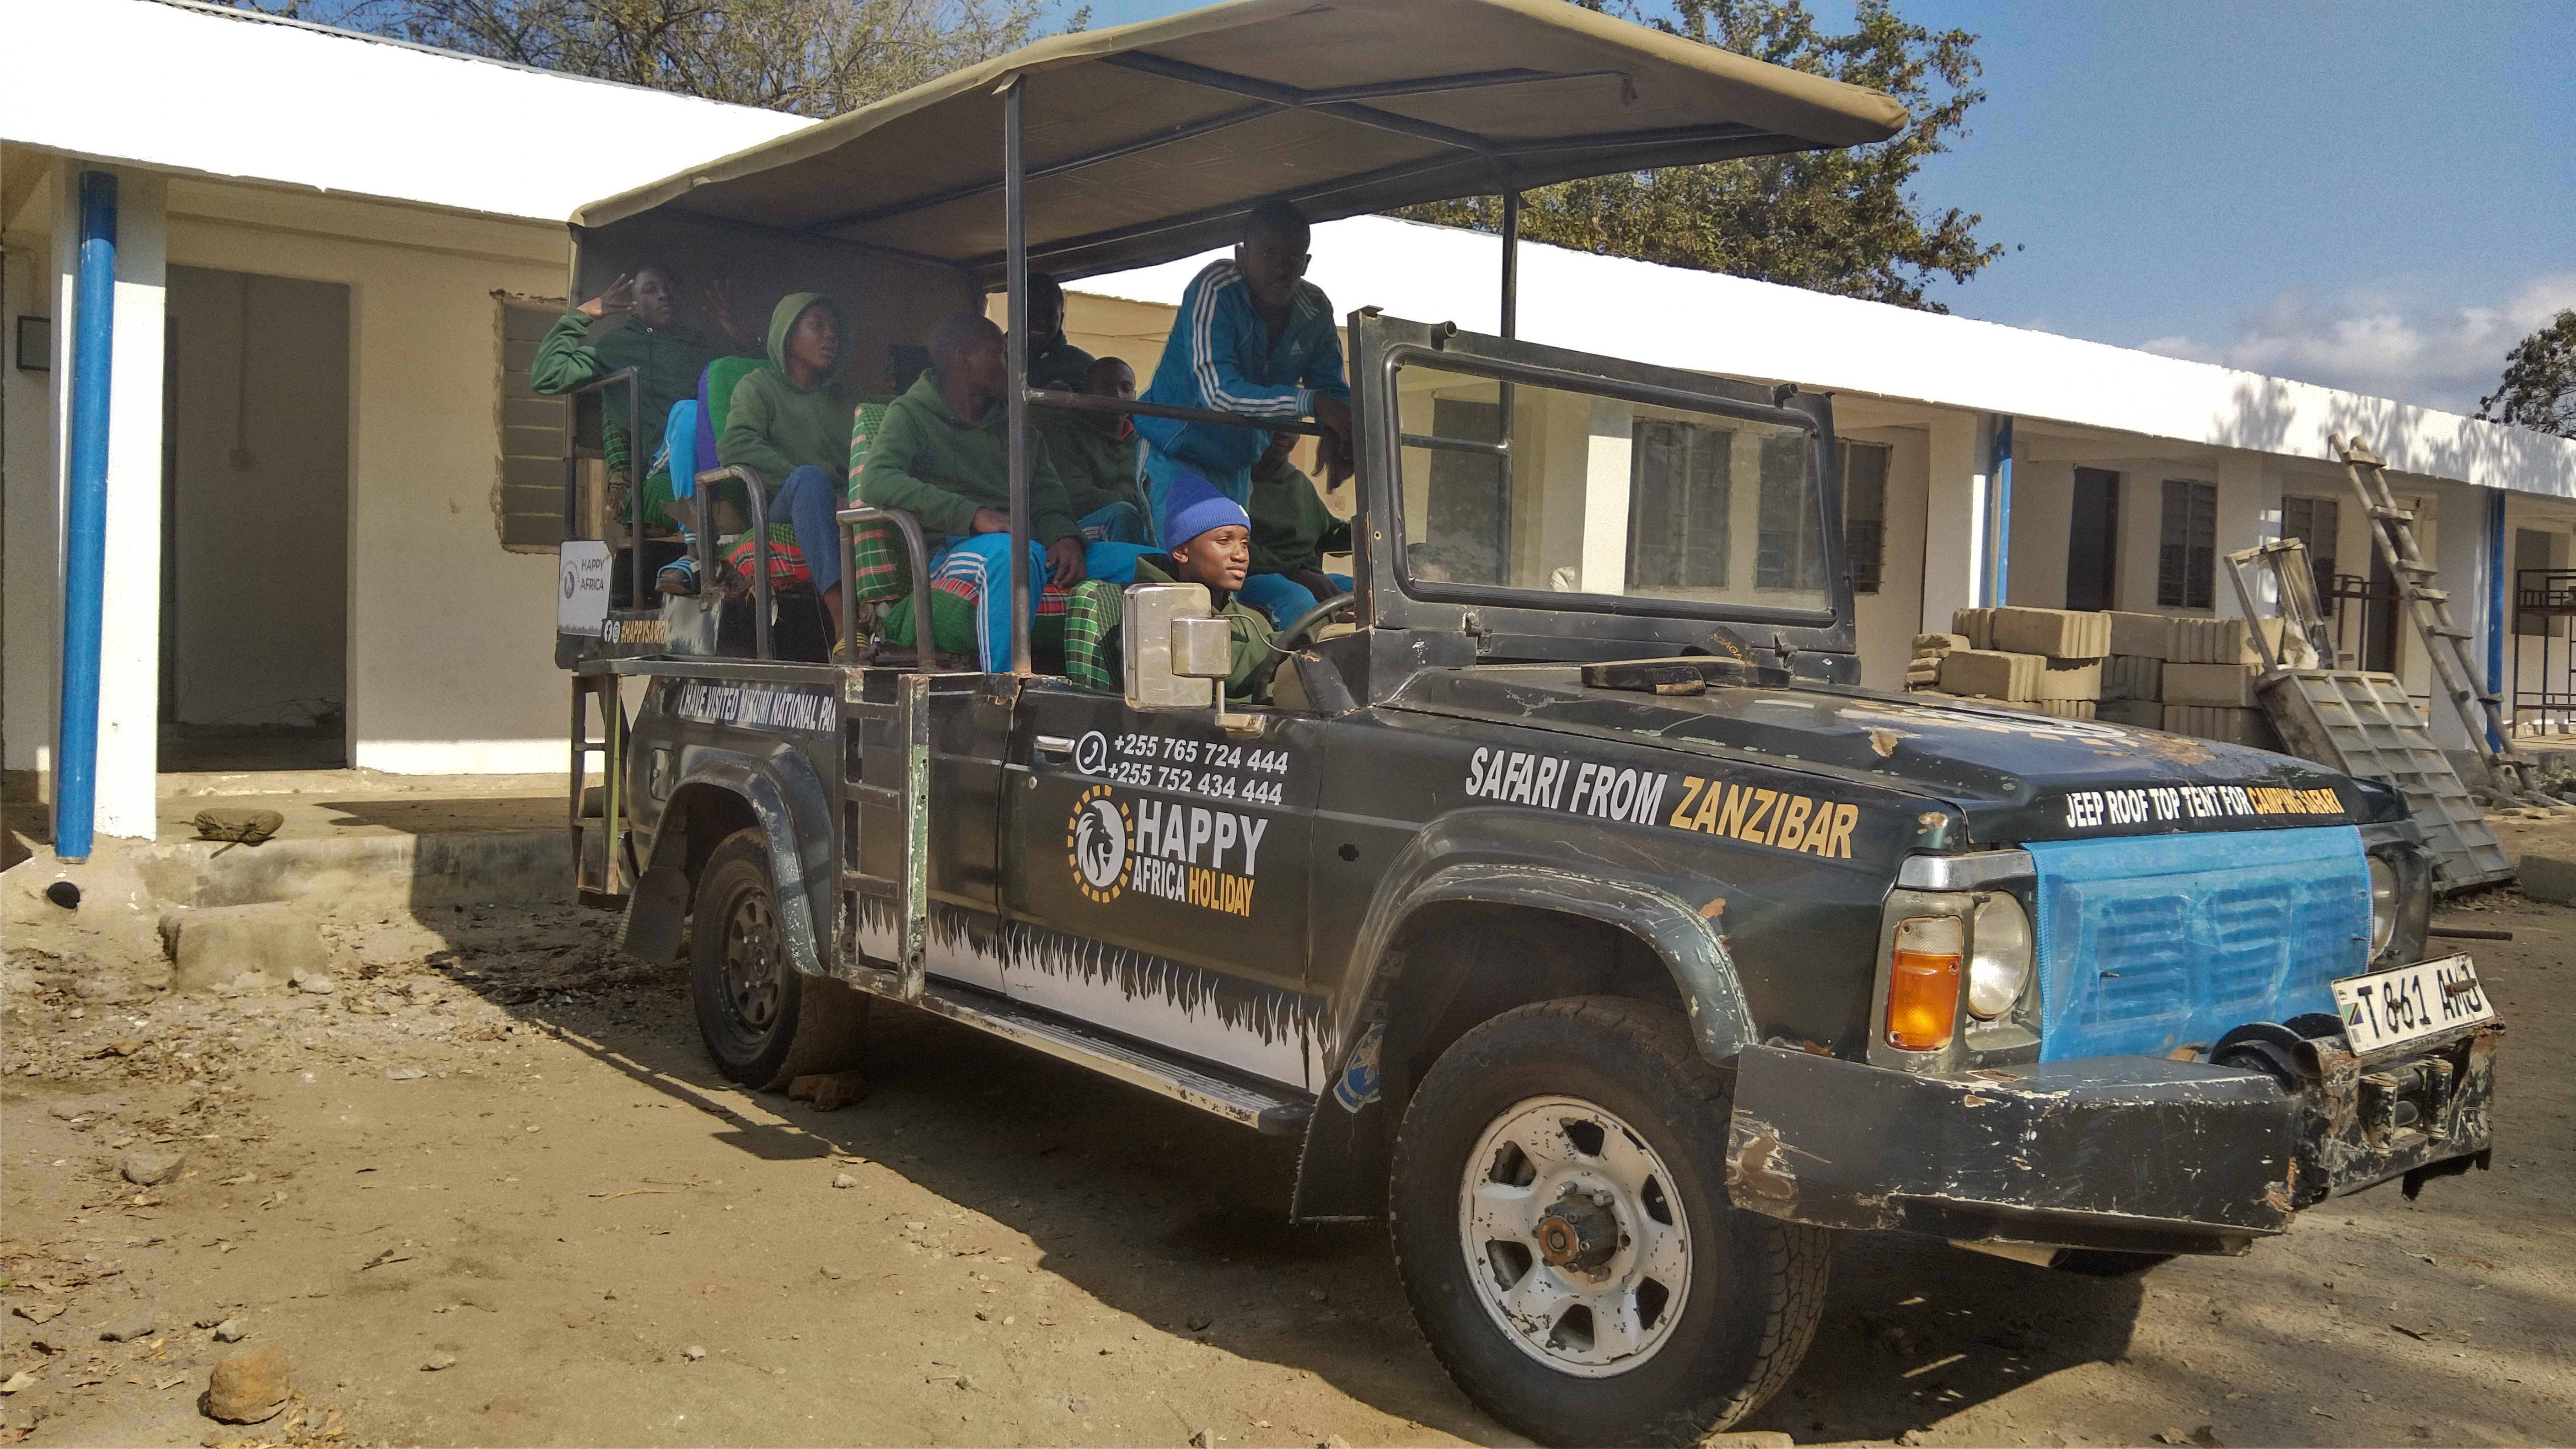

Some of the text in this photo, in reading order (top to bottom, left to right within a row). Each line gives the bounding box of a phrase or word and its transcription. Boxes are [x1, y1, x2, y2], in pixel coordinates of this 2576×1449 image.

[580, 578, 604, 591] AFRICA
[581, 558, 605, 571] HAPPY
[678, 684, 686, 714] I
[683, 684, 708, 717] HAVE
[706, 686, 739, 720] VISITED
[737, 688, 774, 724] MIKUMI
[770, 692, 819, 730] NATIONAL
[1114, 733, 1289, 774] +255 765 724 444
[1108, 761, 1283, 805] +255 752 434 444
[1465, 747, 1859, 859] SAFARI FROM ZANZIBAR
[2066, 785, 2345, 828] JEEP ROOF TOP TENT FOR CAMPING SAFARI
[1136, 798, 1268, 875] HAPPY
[1132, 855, 1255, 917] AFRICA HOLIDAY
[2357, 985, 2380, 1039] T
[2383, 975, 2432, 1034] 861
